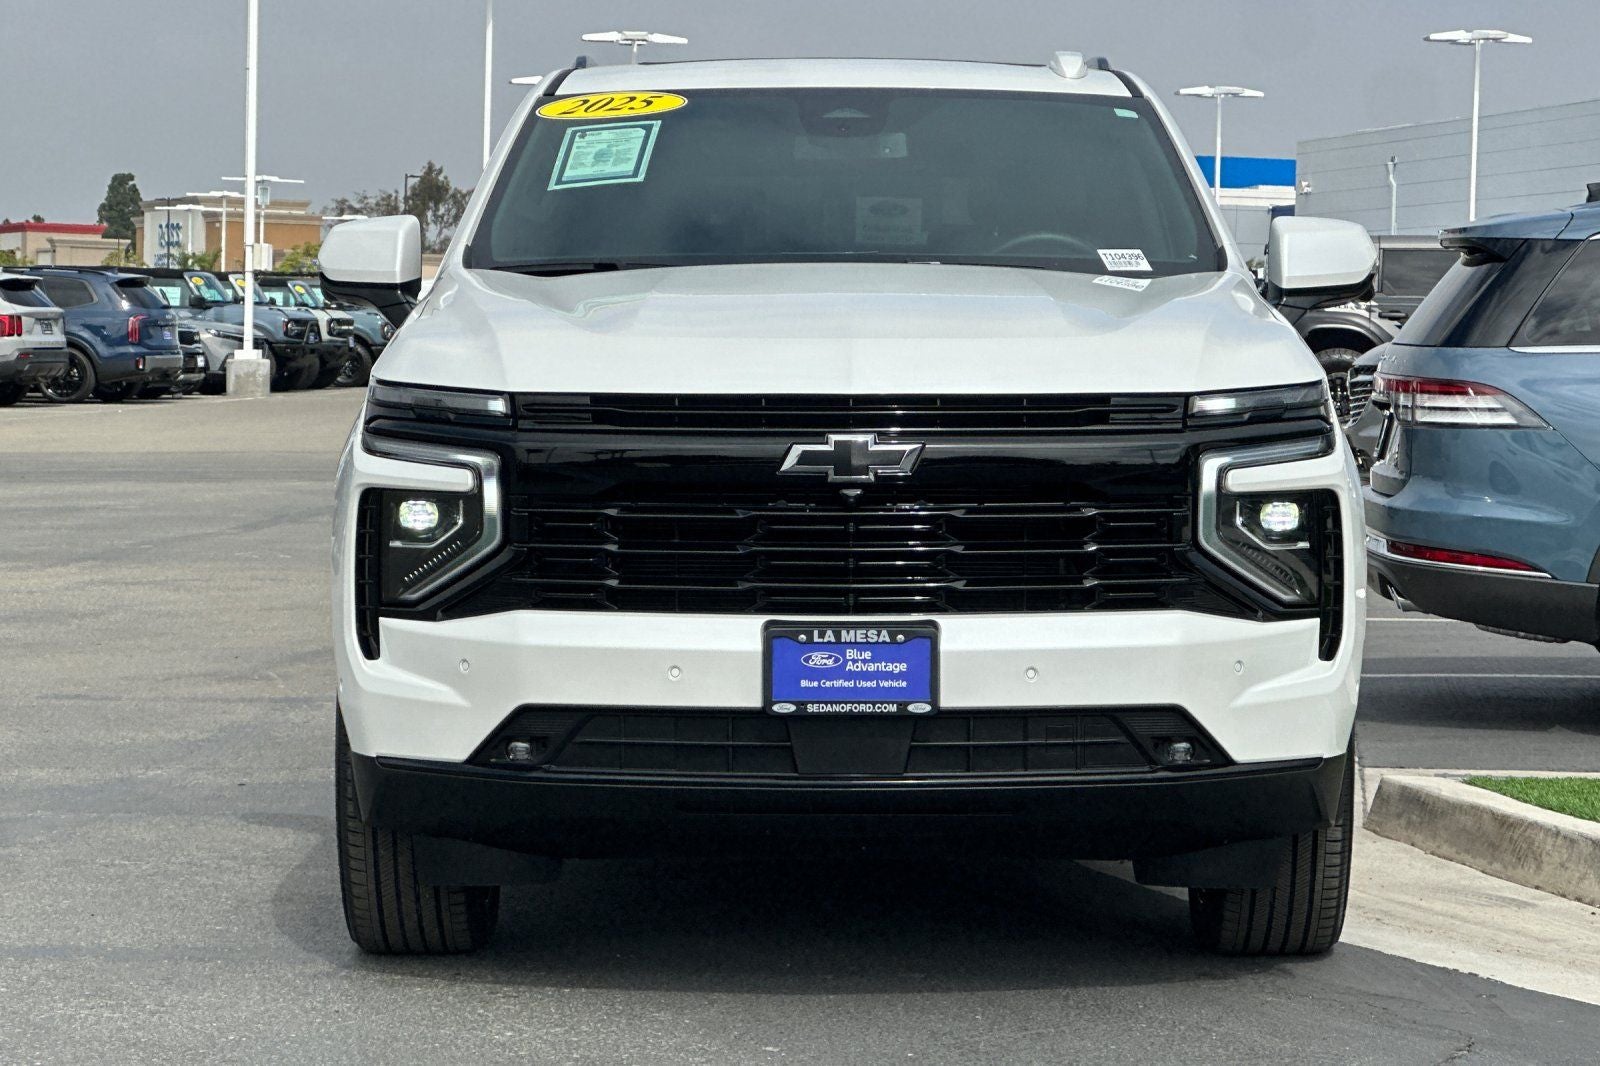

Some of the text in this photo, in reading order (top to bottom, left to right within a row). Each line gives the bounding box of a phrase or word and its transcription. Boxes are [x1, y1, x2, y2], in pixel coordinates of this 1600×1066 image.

[559, 95, 662, 115] 2025
[813, 630, 890, 643] LA MESA
[808, 653, 835, 666] Ford
[846, 649, 872, 660] Blue
[846, 661, 907, 673] Advantage
[800, 679, 907, 688] Blue Certified Used Vehicle
[807, 703, 897, 713] SEDANOFORD.COM
